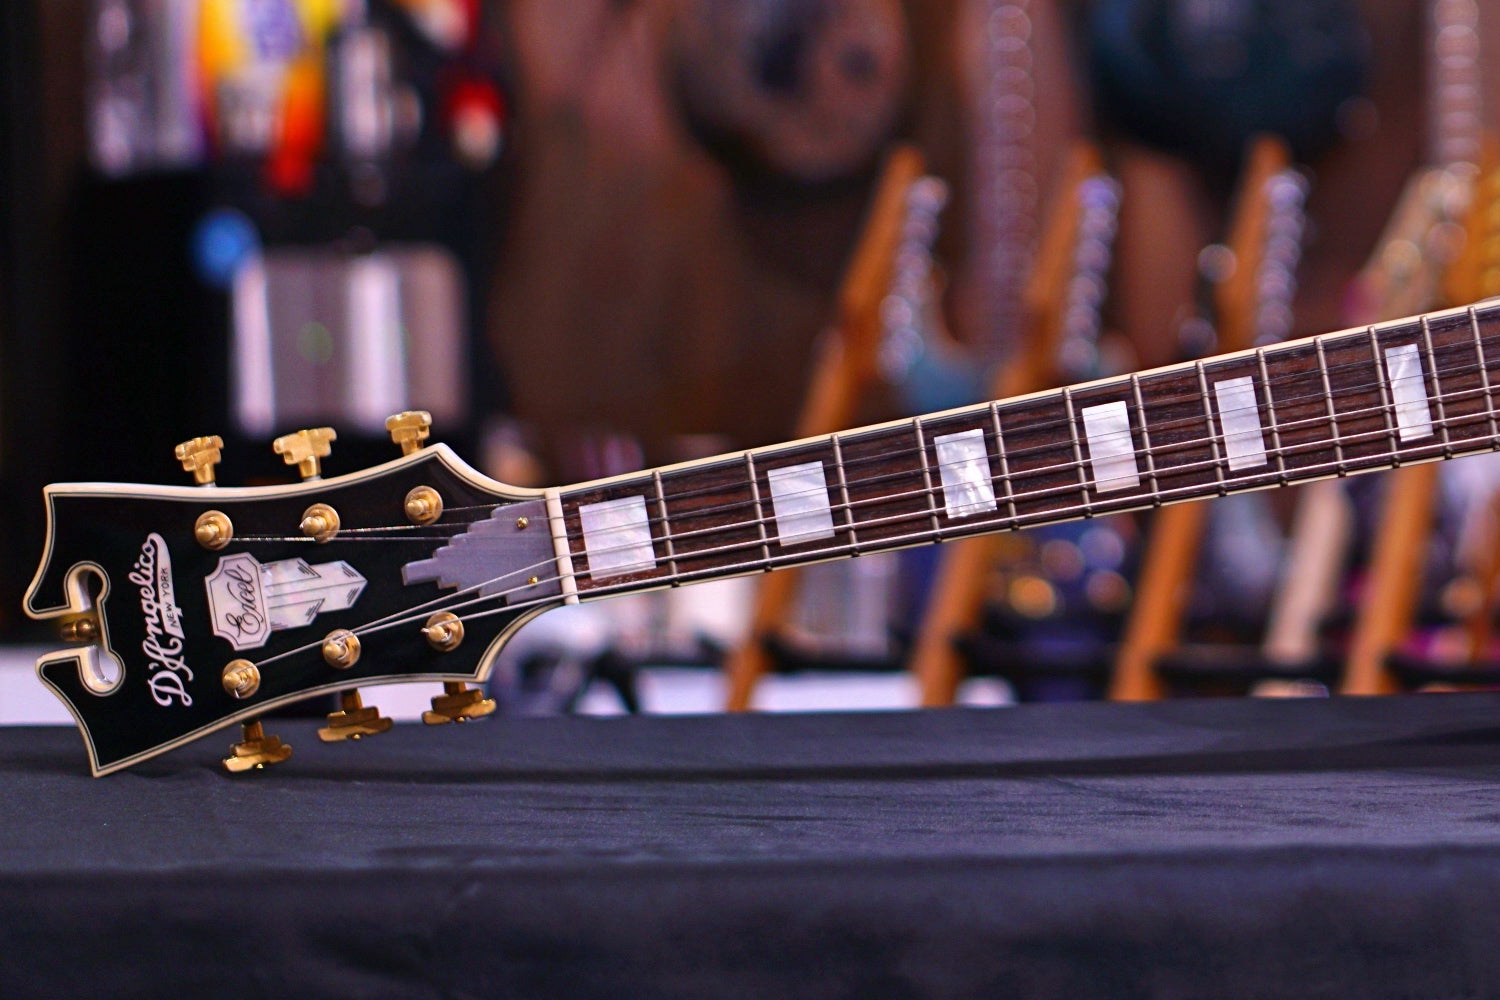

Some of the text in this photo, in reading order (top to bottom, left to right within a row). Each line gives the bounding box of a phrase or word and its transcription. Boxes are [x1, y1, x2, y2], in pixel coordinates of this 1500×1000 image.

[128, 532, 194, 707] D'Angelico
[160, 567, 179, 629] NEW YORK
[225, 564, 263, 637] Excel
